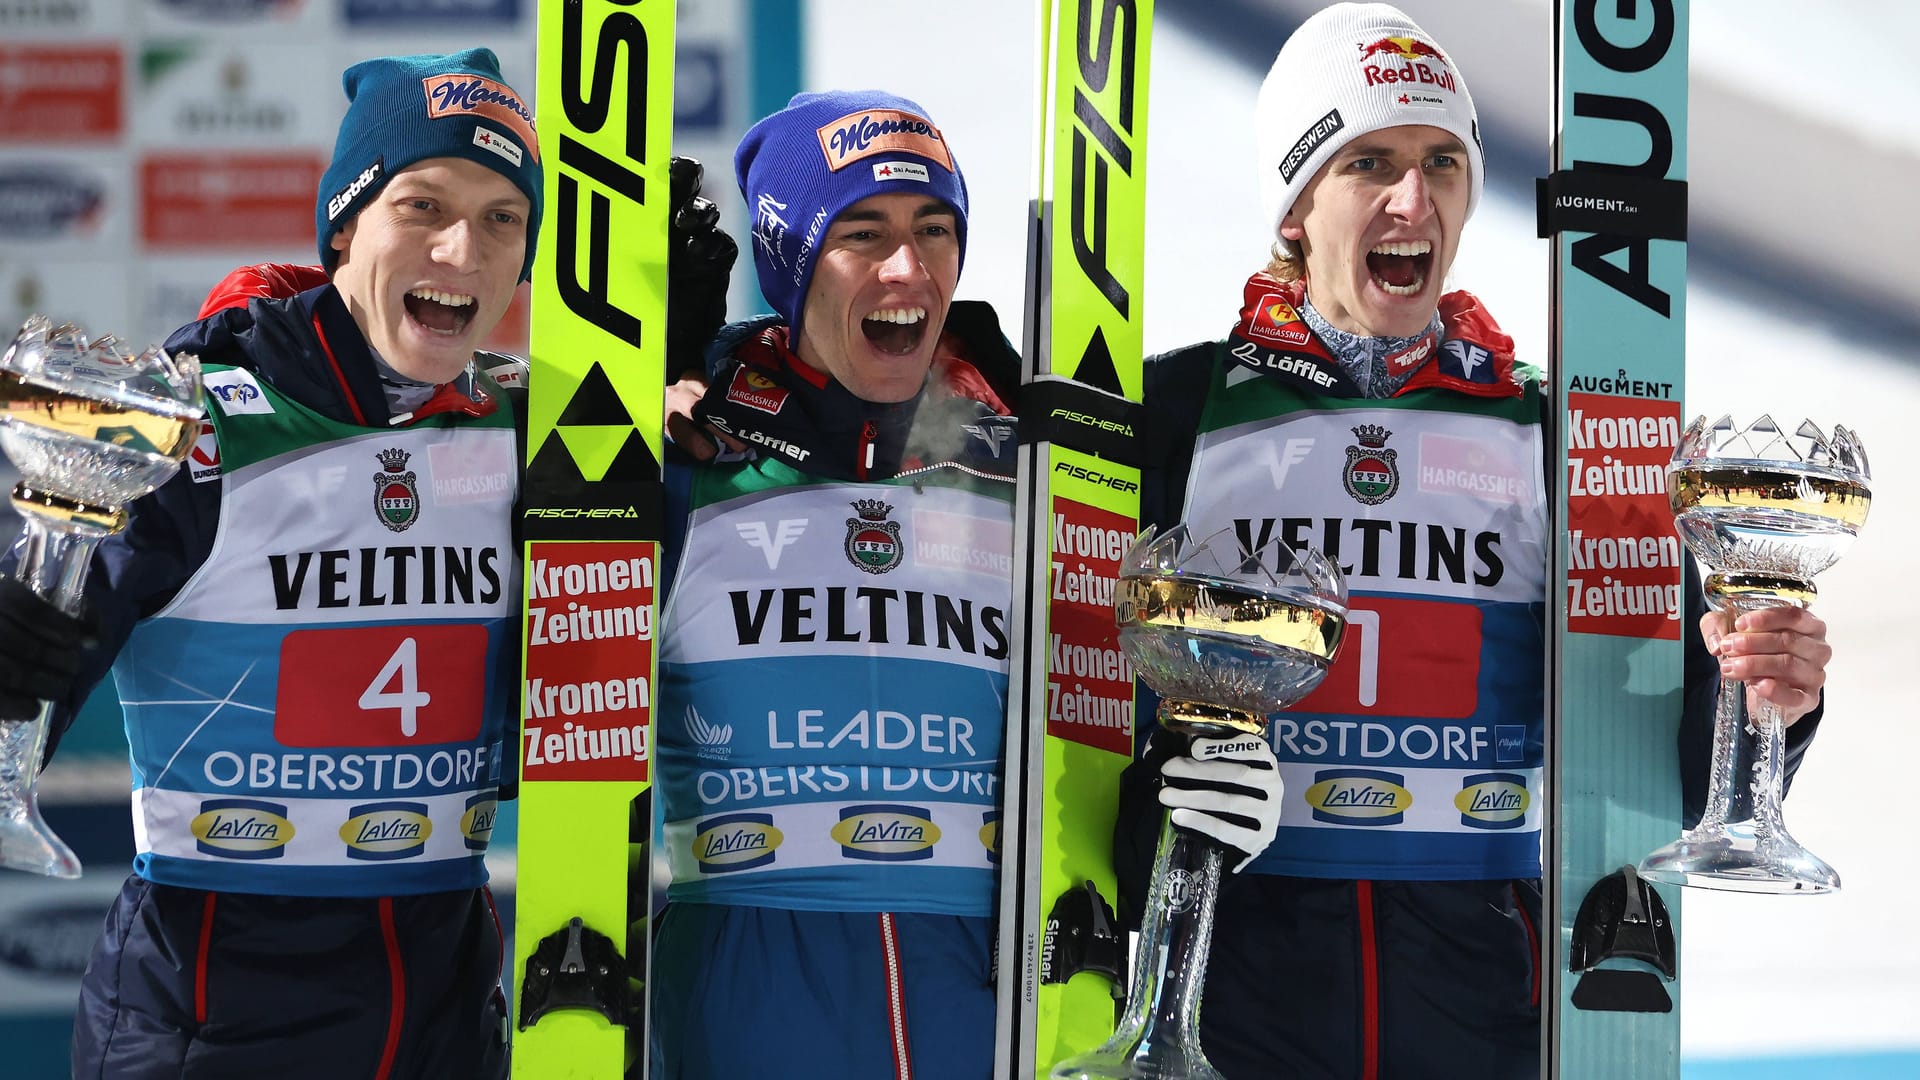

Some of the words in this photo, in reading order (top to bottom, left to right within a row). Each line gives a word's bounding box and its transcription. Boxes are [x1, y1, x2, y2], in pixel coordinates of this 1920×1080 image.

[1363, 62, 1416, 87] Red
[1418, 63, 1456, 94] Bull
[1411, 95, 1422, 103] Ski
[1422, 95, 1443, 104] Austria
[830, 115, 940, 159] Manner
[1281, 114, 1338, 179] GIESSWEIN
[327, 163, 380, 221] Eisbär
[556, 0, 649, 349] FIS
[893, 166, 904, 174] Ski
[905, 167, 926, 176] Austria
[793, 206, 828, 287] GIESSWEIN
[1252, 325, 1306, 341] HARGASSNER
[1394, 337, 1432, 367] Tirol
[1266, 352, 1338, 388] Löffler
[1569, 375, 1672, 399] AUGMENT
[1051, 408, 1126, 434] FISCHER
[1567, 408, 1678, 450] Kronen
[434, 472, 509, 498] HARGASSNER
[1054, 461, 1138, 495] FISCHER
[1422, 465, 1530, 498] HARGASSNER
[524, 508, 625, 518] FISCHER
[1052, 513, 1136, 562] Kronen
[1234, 517, 1505, 587] VELTINS
[1567, 530, 1680, 571] Kronen
[267, 546, 501, 610] VELTINS
[528, 555, 653, 600] Kronen
[1051, 562, 1119, 607] Zeitu
[1567, 576, 1681, 621] Zeitung
[528, 602, 654, 647] Zeitung
[728, 586, 1009, 661] VELTINS
[1048, 632, 1132, 684] Kronen
[358, 637, 431, 738] 4
[524, 675, 649, 720] Kronen
[1048, 682, 1133, 737] Zeitung
[523, 721, 649, 766] Zeitung
[767, 709, 976, 757] LEADER
[1273, 719, 1488, 762] RSTDORF
[204, 746, 487, 792] OBERSTDORF
